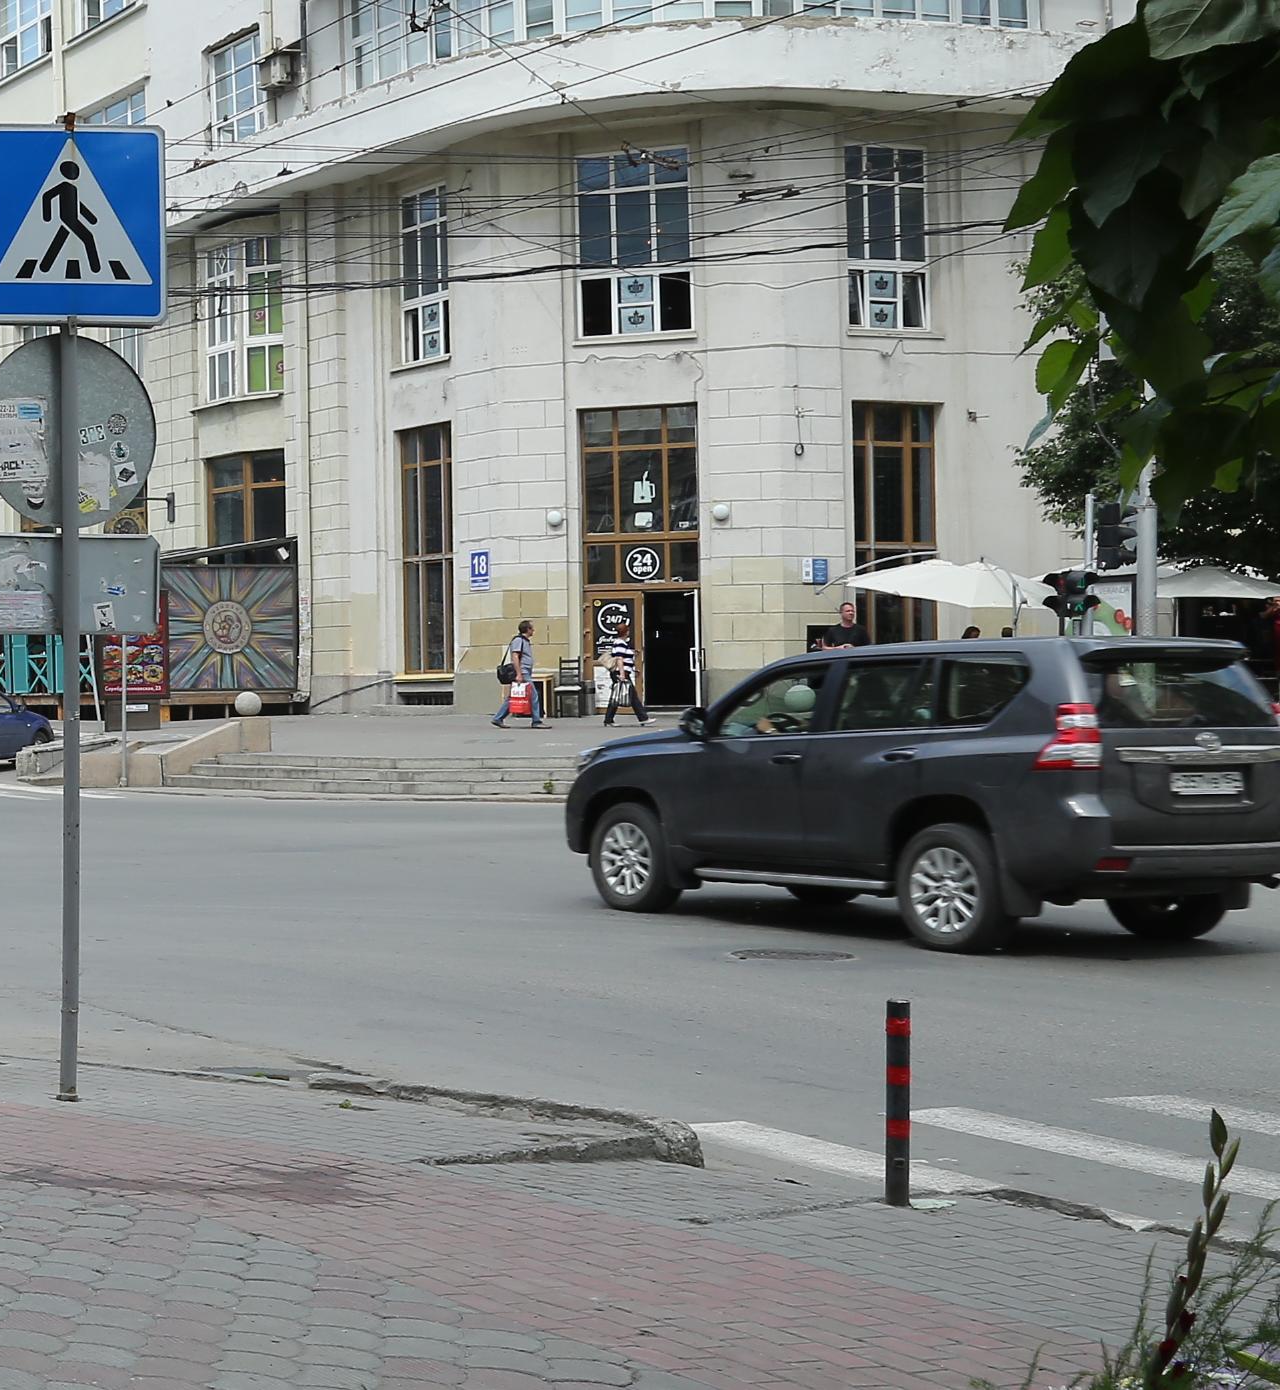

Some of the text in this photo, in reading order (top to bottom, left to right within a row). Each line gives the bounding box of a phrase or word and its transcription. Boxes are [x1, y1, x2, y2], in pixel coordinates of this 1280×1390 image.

[472, 555, 487, 575] 18
[632, 553, 653, 566] 24
[632, 565, 653, 574] open
[606, 614, 623, 624] 24/7
